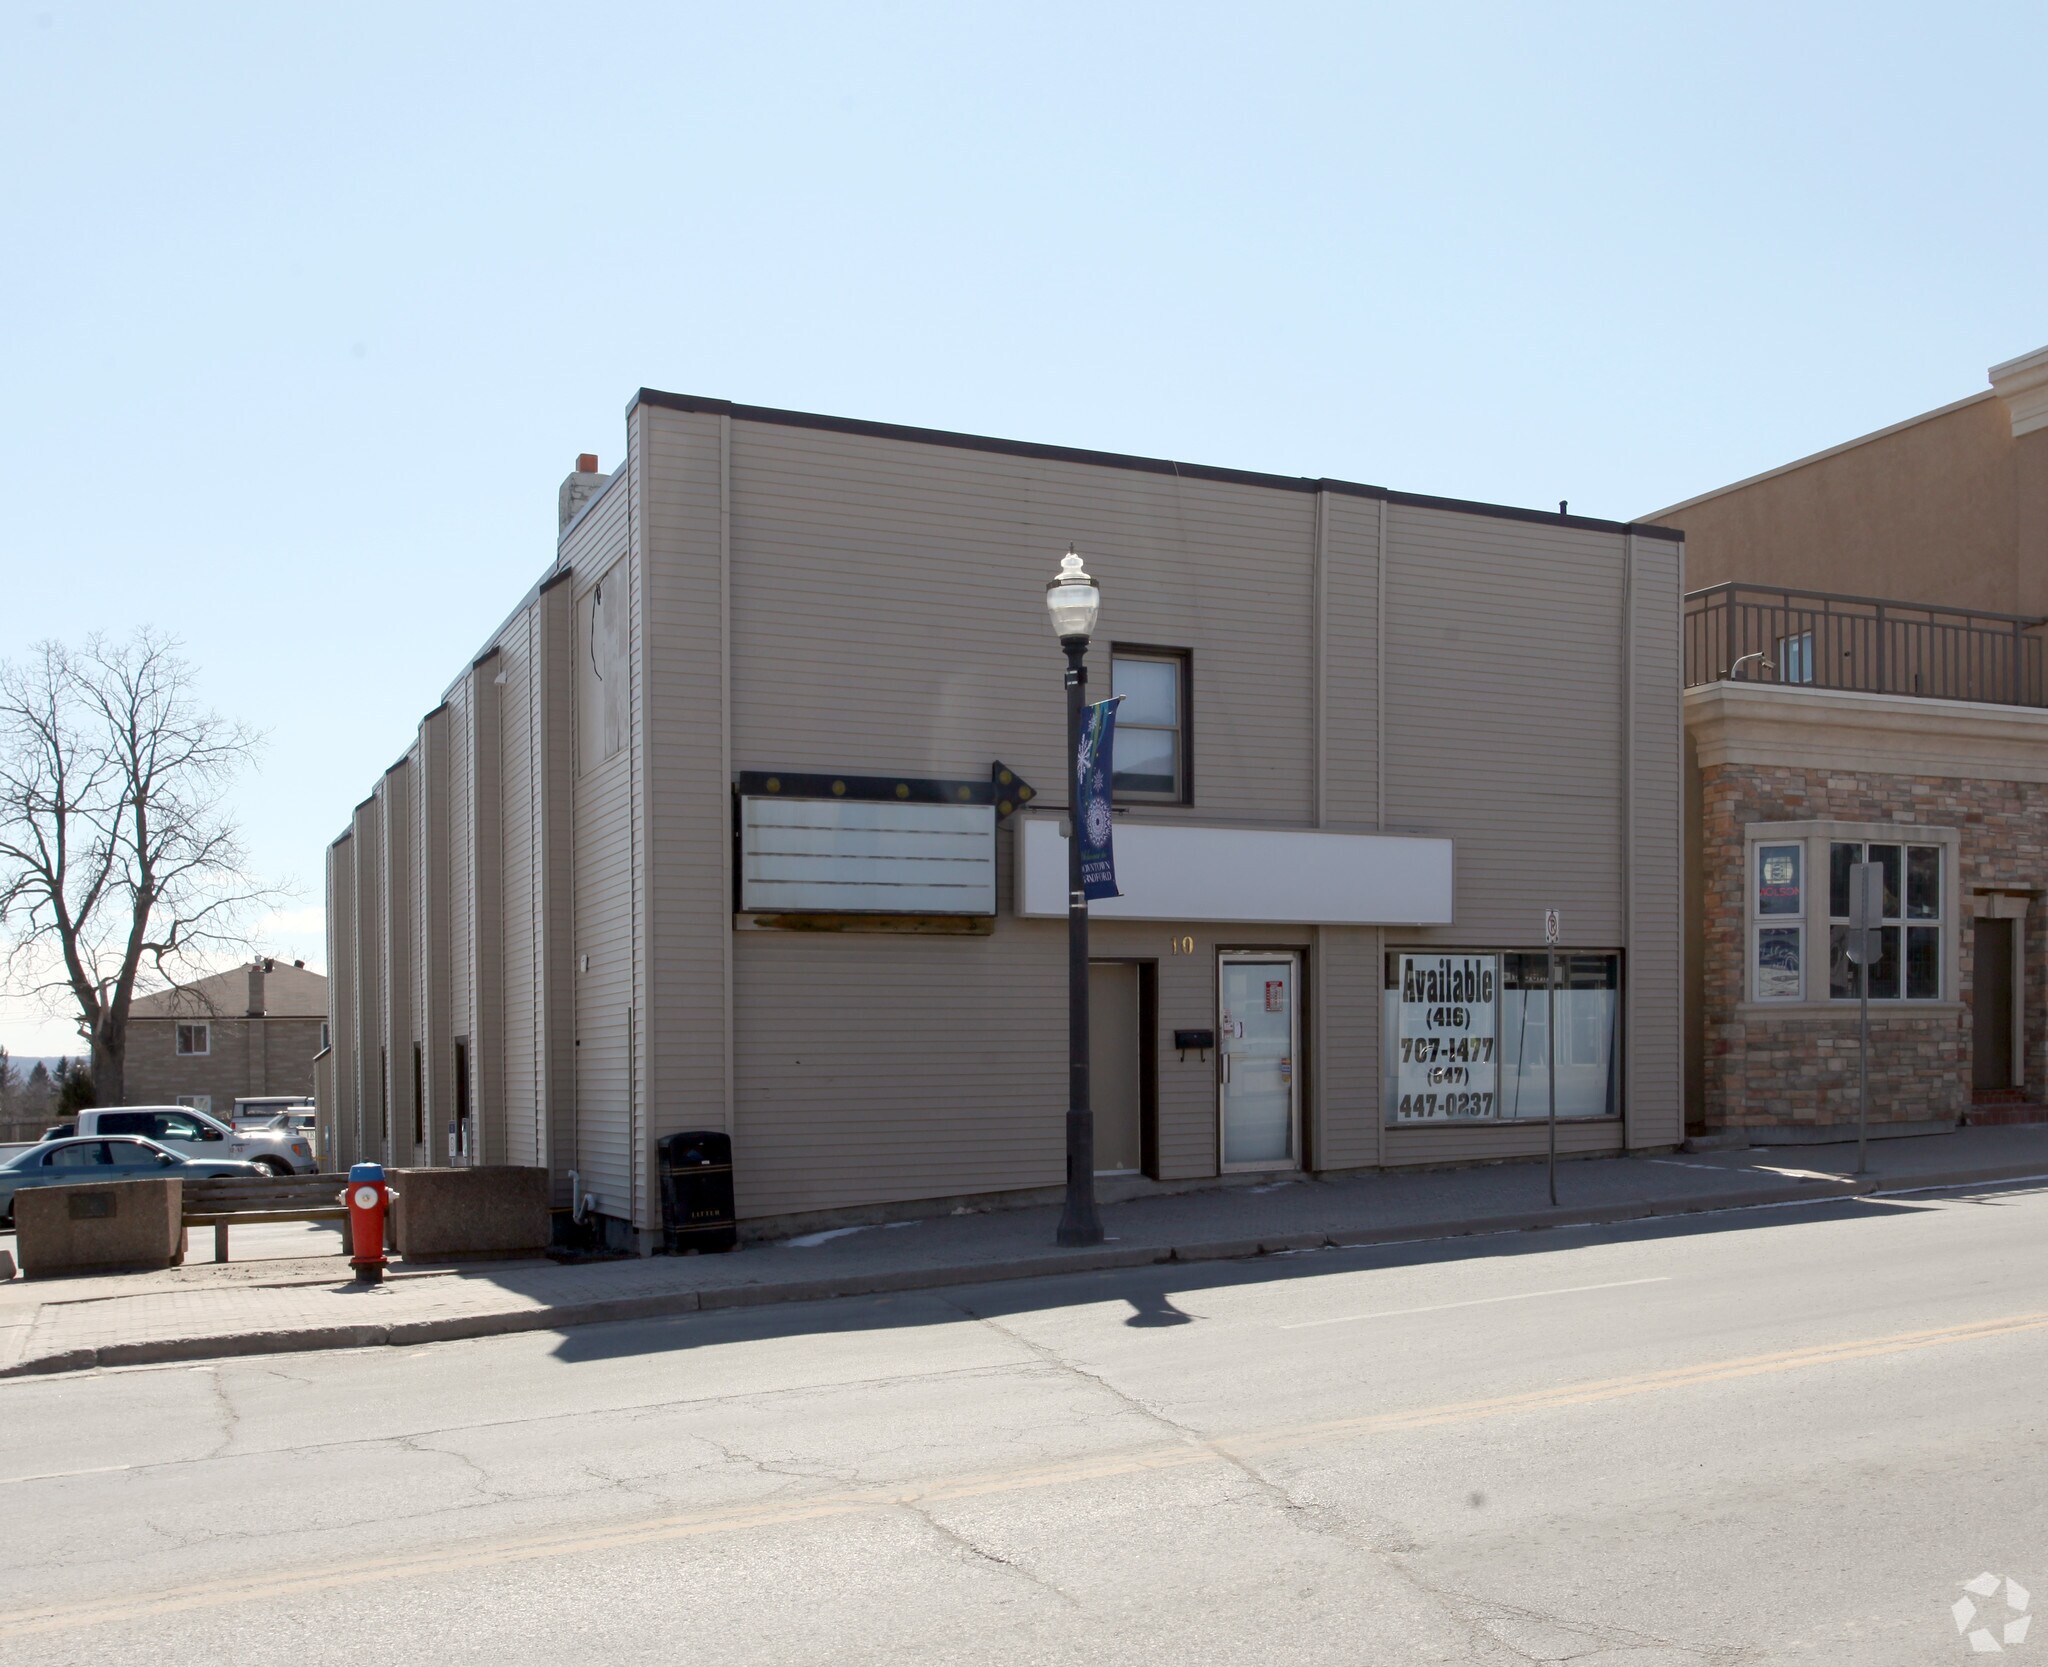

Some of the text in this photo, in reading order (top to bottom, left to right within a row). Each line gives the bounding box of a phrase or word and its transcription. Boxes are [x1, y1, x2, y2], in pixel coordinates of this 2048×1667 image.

[1171, 936, 1194, 955] 10
[1403, 958, 1493, 1004] Available
[1426, 1006, 1471, 1031] (416)
[1401, 1037, 1494, 1064] 707-1477
[1427, 1066, 1469, 1087] (647)
[1399, 1092, 1493, 1118] 447-0237
